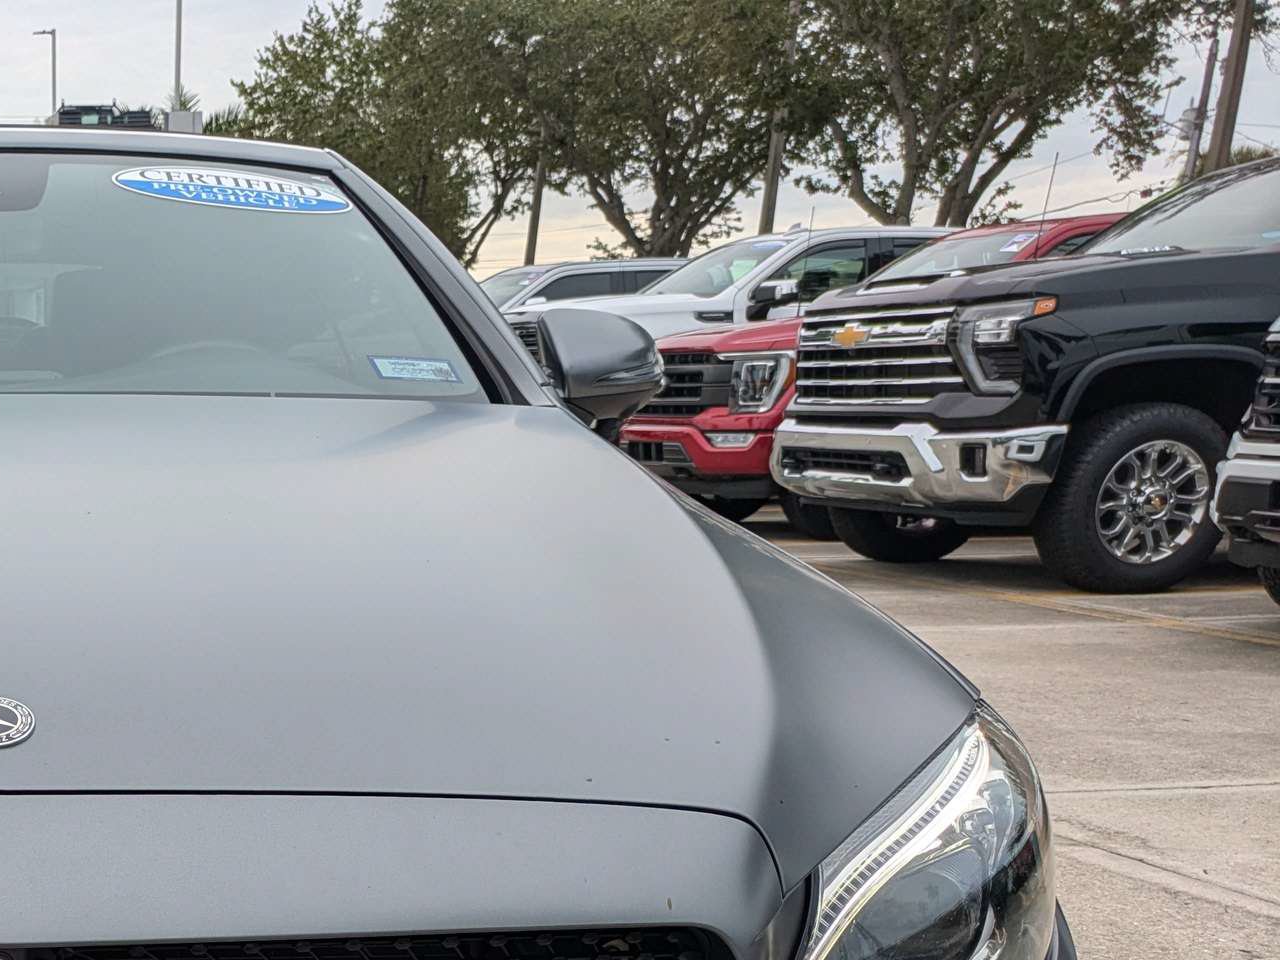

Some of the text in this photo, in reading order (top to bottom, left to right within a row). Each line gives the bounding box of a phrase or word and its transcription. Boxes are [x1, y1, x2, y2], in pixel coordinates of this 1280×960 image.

[138, 169, 323, 198] CERTIFIED
[151, 182, 319, 205] PRE-OWNED
[181, 190, 299, 209] VEHICLE
